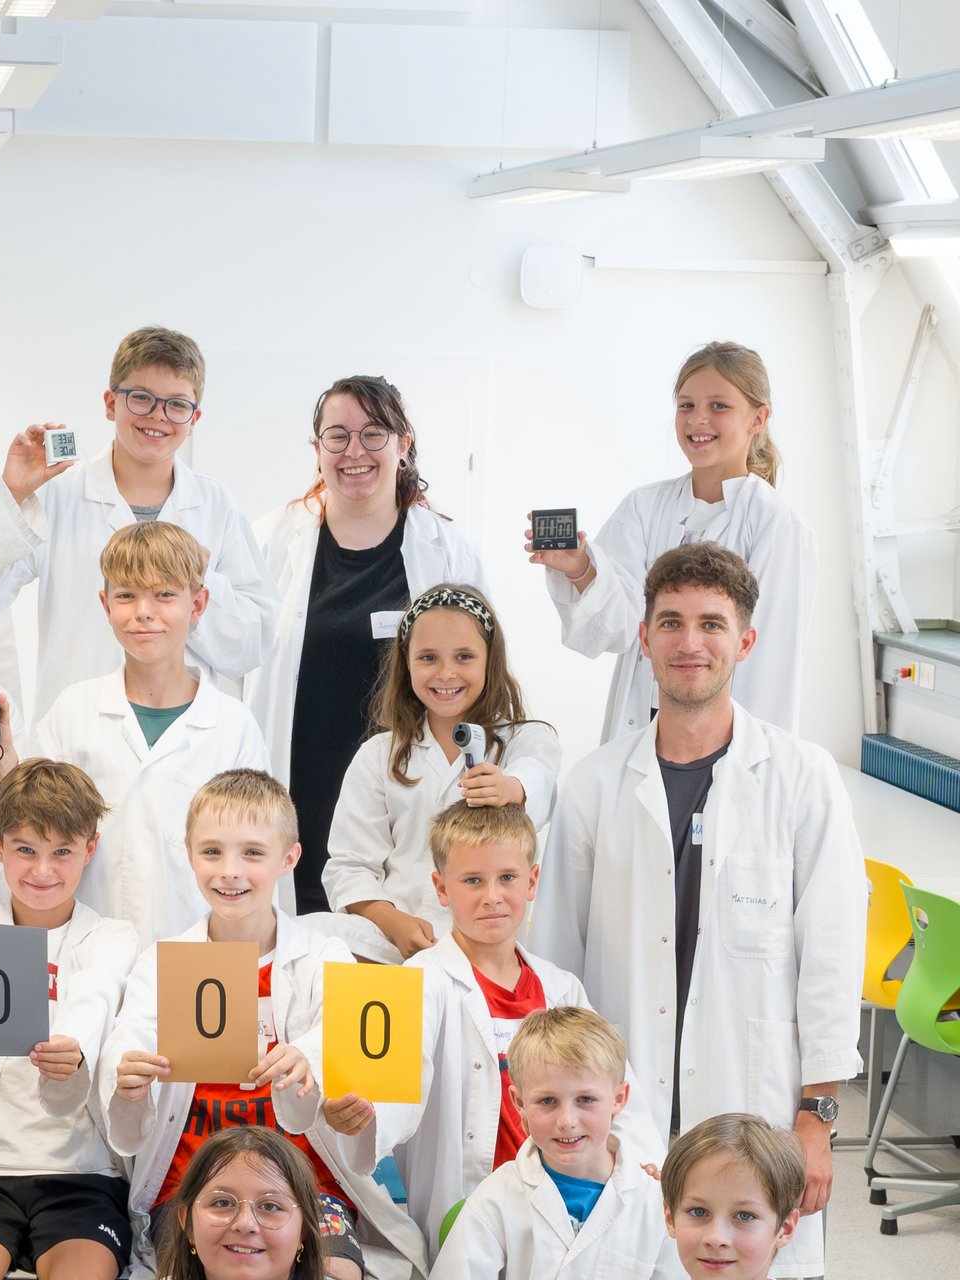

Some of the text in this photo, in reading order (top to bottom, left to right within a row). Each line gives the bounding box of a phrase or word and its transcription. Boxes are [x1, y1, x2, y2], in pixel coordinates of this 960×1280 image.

[732, 893, 768, 905] MATTHIAS
[195, 978, 227, 1039] 0
[360, 1000, 391, 1060] 0
